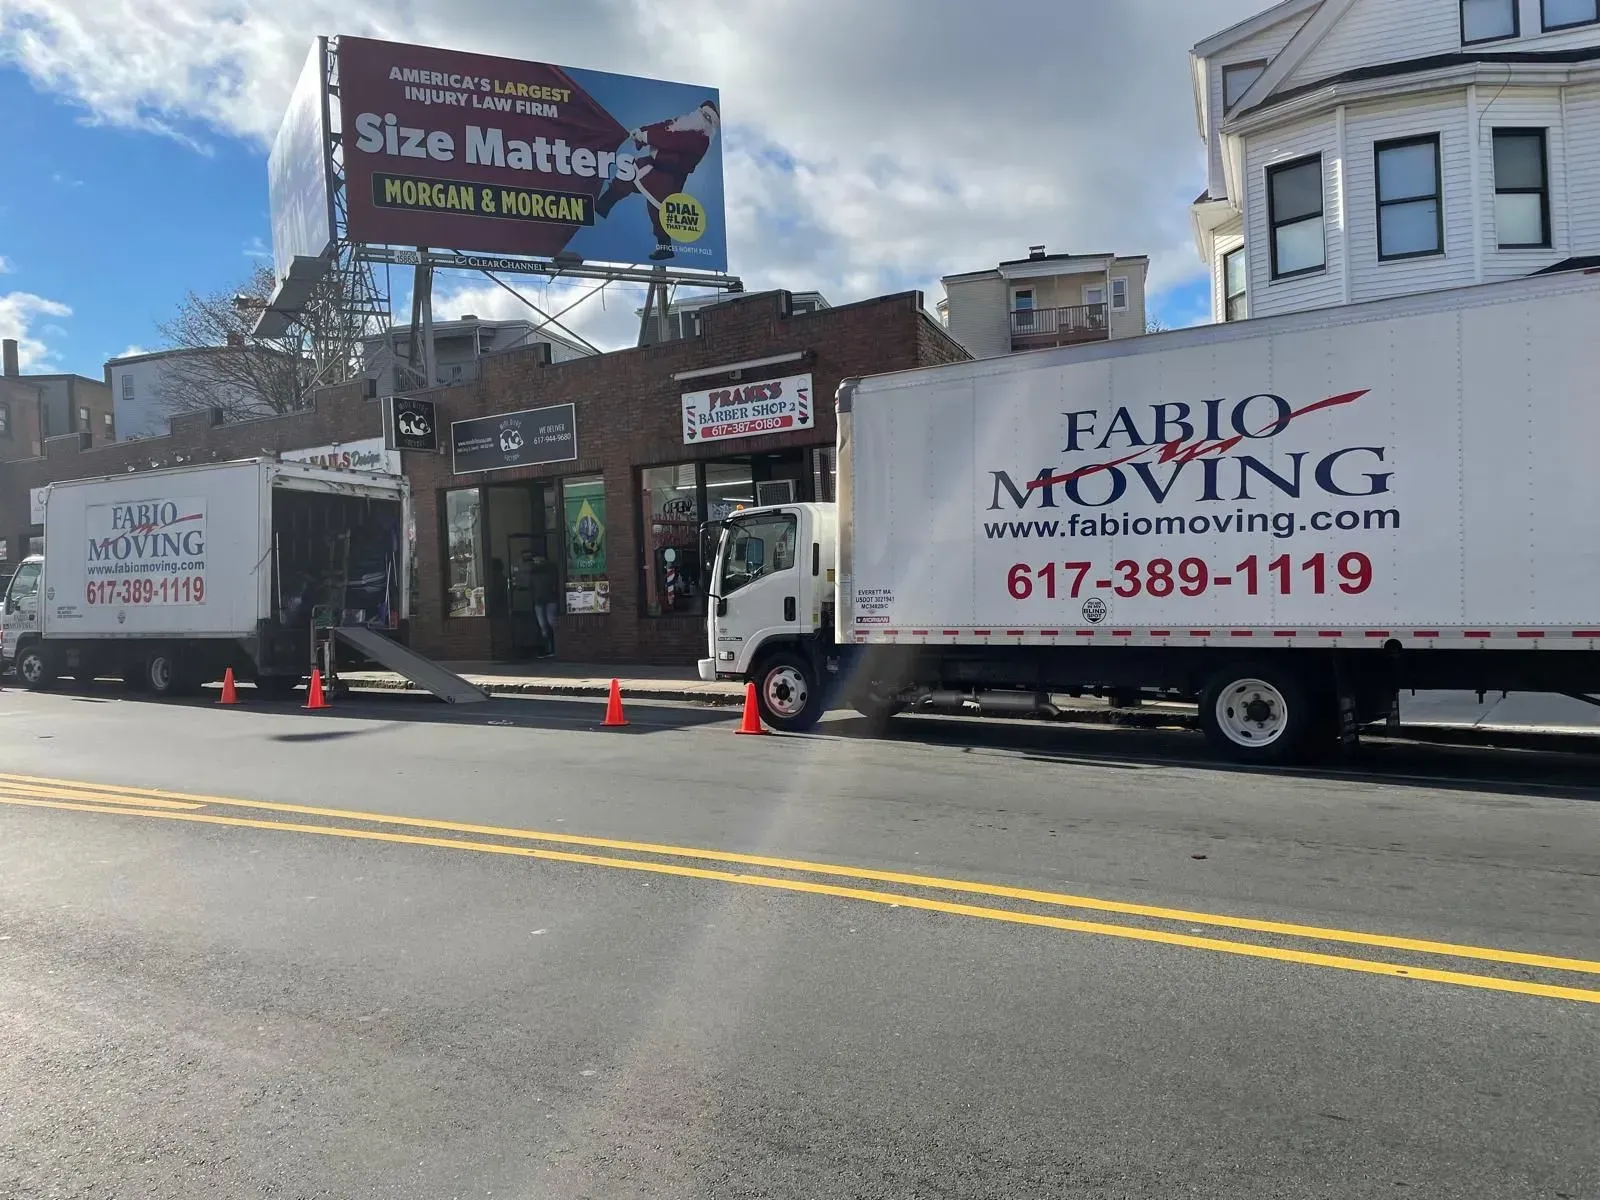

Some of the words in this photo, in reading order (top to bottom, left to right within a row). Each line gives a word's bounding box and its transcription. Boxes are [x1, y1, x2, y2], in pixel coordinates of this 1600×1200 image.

[389, 66, 490, 92] AMERICA'S
[494, 81, 571, 103] LARGEST
[404, 86, 469, 106] INJURY
[472, 94, 511, 112] LAW
[515, 100, 558, 118] FIRM
[355, 112, 455, 161] Size
[465, 125, 637, 182] Matters
[384, 178, 475, 211] MORGAN
[481, 188, 496, 213] &
[501, 191, 585, 221] MORGAN
[665, 202, 699, 216] DIAL
[665, 223, 687, 231] THAT'S
[666, 213, 699, 226] #LAW
[655, 244, 678, 252] OFFICES
[679, 246, 698, 254] NORTH
[698, 248, 713, 256] POLE
[708, 381, 783, 412] FRANK'S
[699, 406, 749, 425] BARBER
[751, 401, 787, 417] SHOP
[788, 402, 796, 412] 2
[711, 417, 782, 436] 617-387-0180
[1061, 393, 1292, 452] FABIO
[533, 432, 572, 445] 617-944-9680
[538, 425, 546, 434] WE
[546, 423, 565, 434] DELIVER
[986, 446, 1396, 511] MOVING
[112, 501, 178, 531] FABIO
[983, 507, 1401, 540] www.fabiomoving.com
[88, 530, 205, 561] MOVING
[87, 560, 205, 575] www.fabiomoving.com
[1007, 551, 1373, 600] 617-389-1119
[87, 576, 204, 605] 617-389-1119
